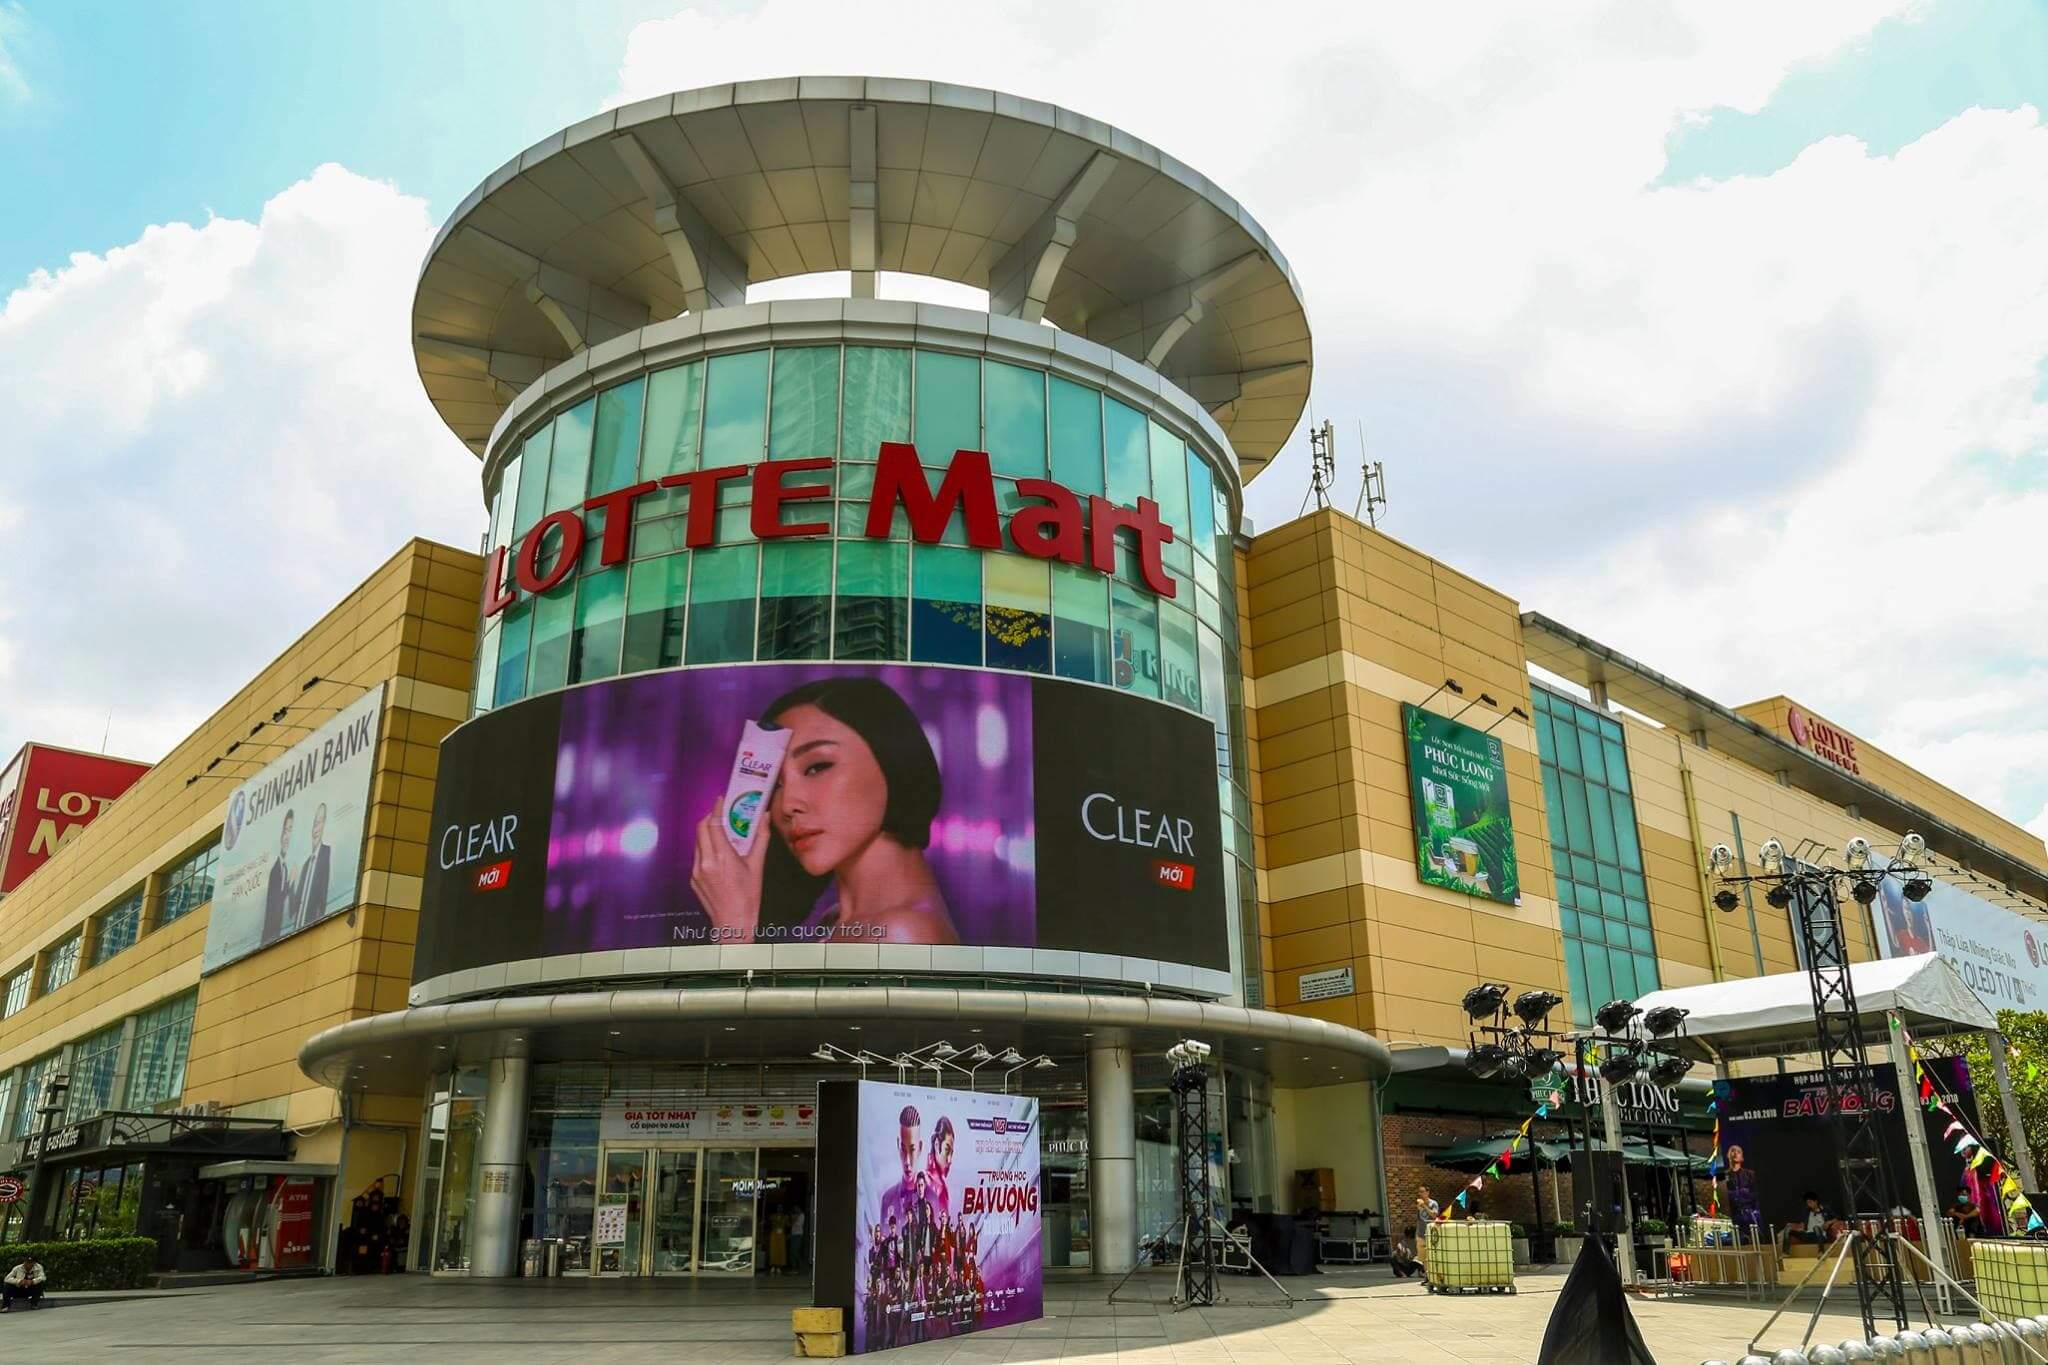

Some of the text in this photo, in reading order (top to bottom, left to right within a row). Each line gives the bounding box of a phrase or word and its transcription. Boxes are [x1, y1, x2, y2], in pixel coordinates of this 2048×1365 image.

[483, 441, 1177, 618] LOTTE Mart
[1808, 717, 1857, 761] LOTTE
[246, 709, 374, 826] SHINHAN BANK
[1424, 744, 1494, 781] PHÚC LONG
[440, 814, 518, 870] CLEAR
[1081, 792, 1195, 857] CLEAR
[673, 925, 707, 940] Như
[792, 924, 835, 940] quay
[1964, 961, 1996, 995] OLED
[1995, 971, 2012, 1000] TV
[1631, 1081, 1680, 1112] LONG
[288, 1193, 308, 1201] ATM
[963, 1179, 984, 1214] BÁ
